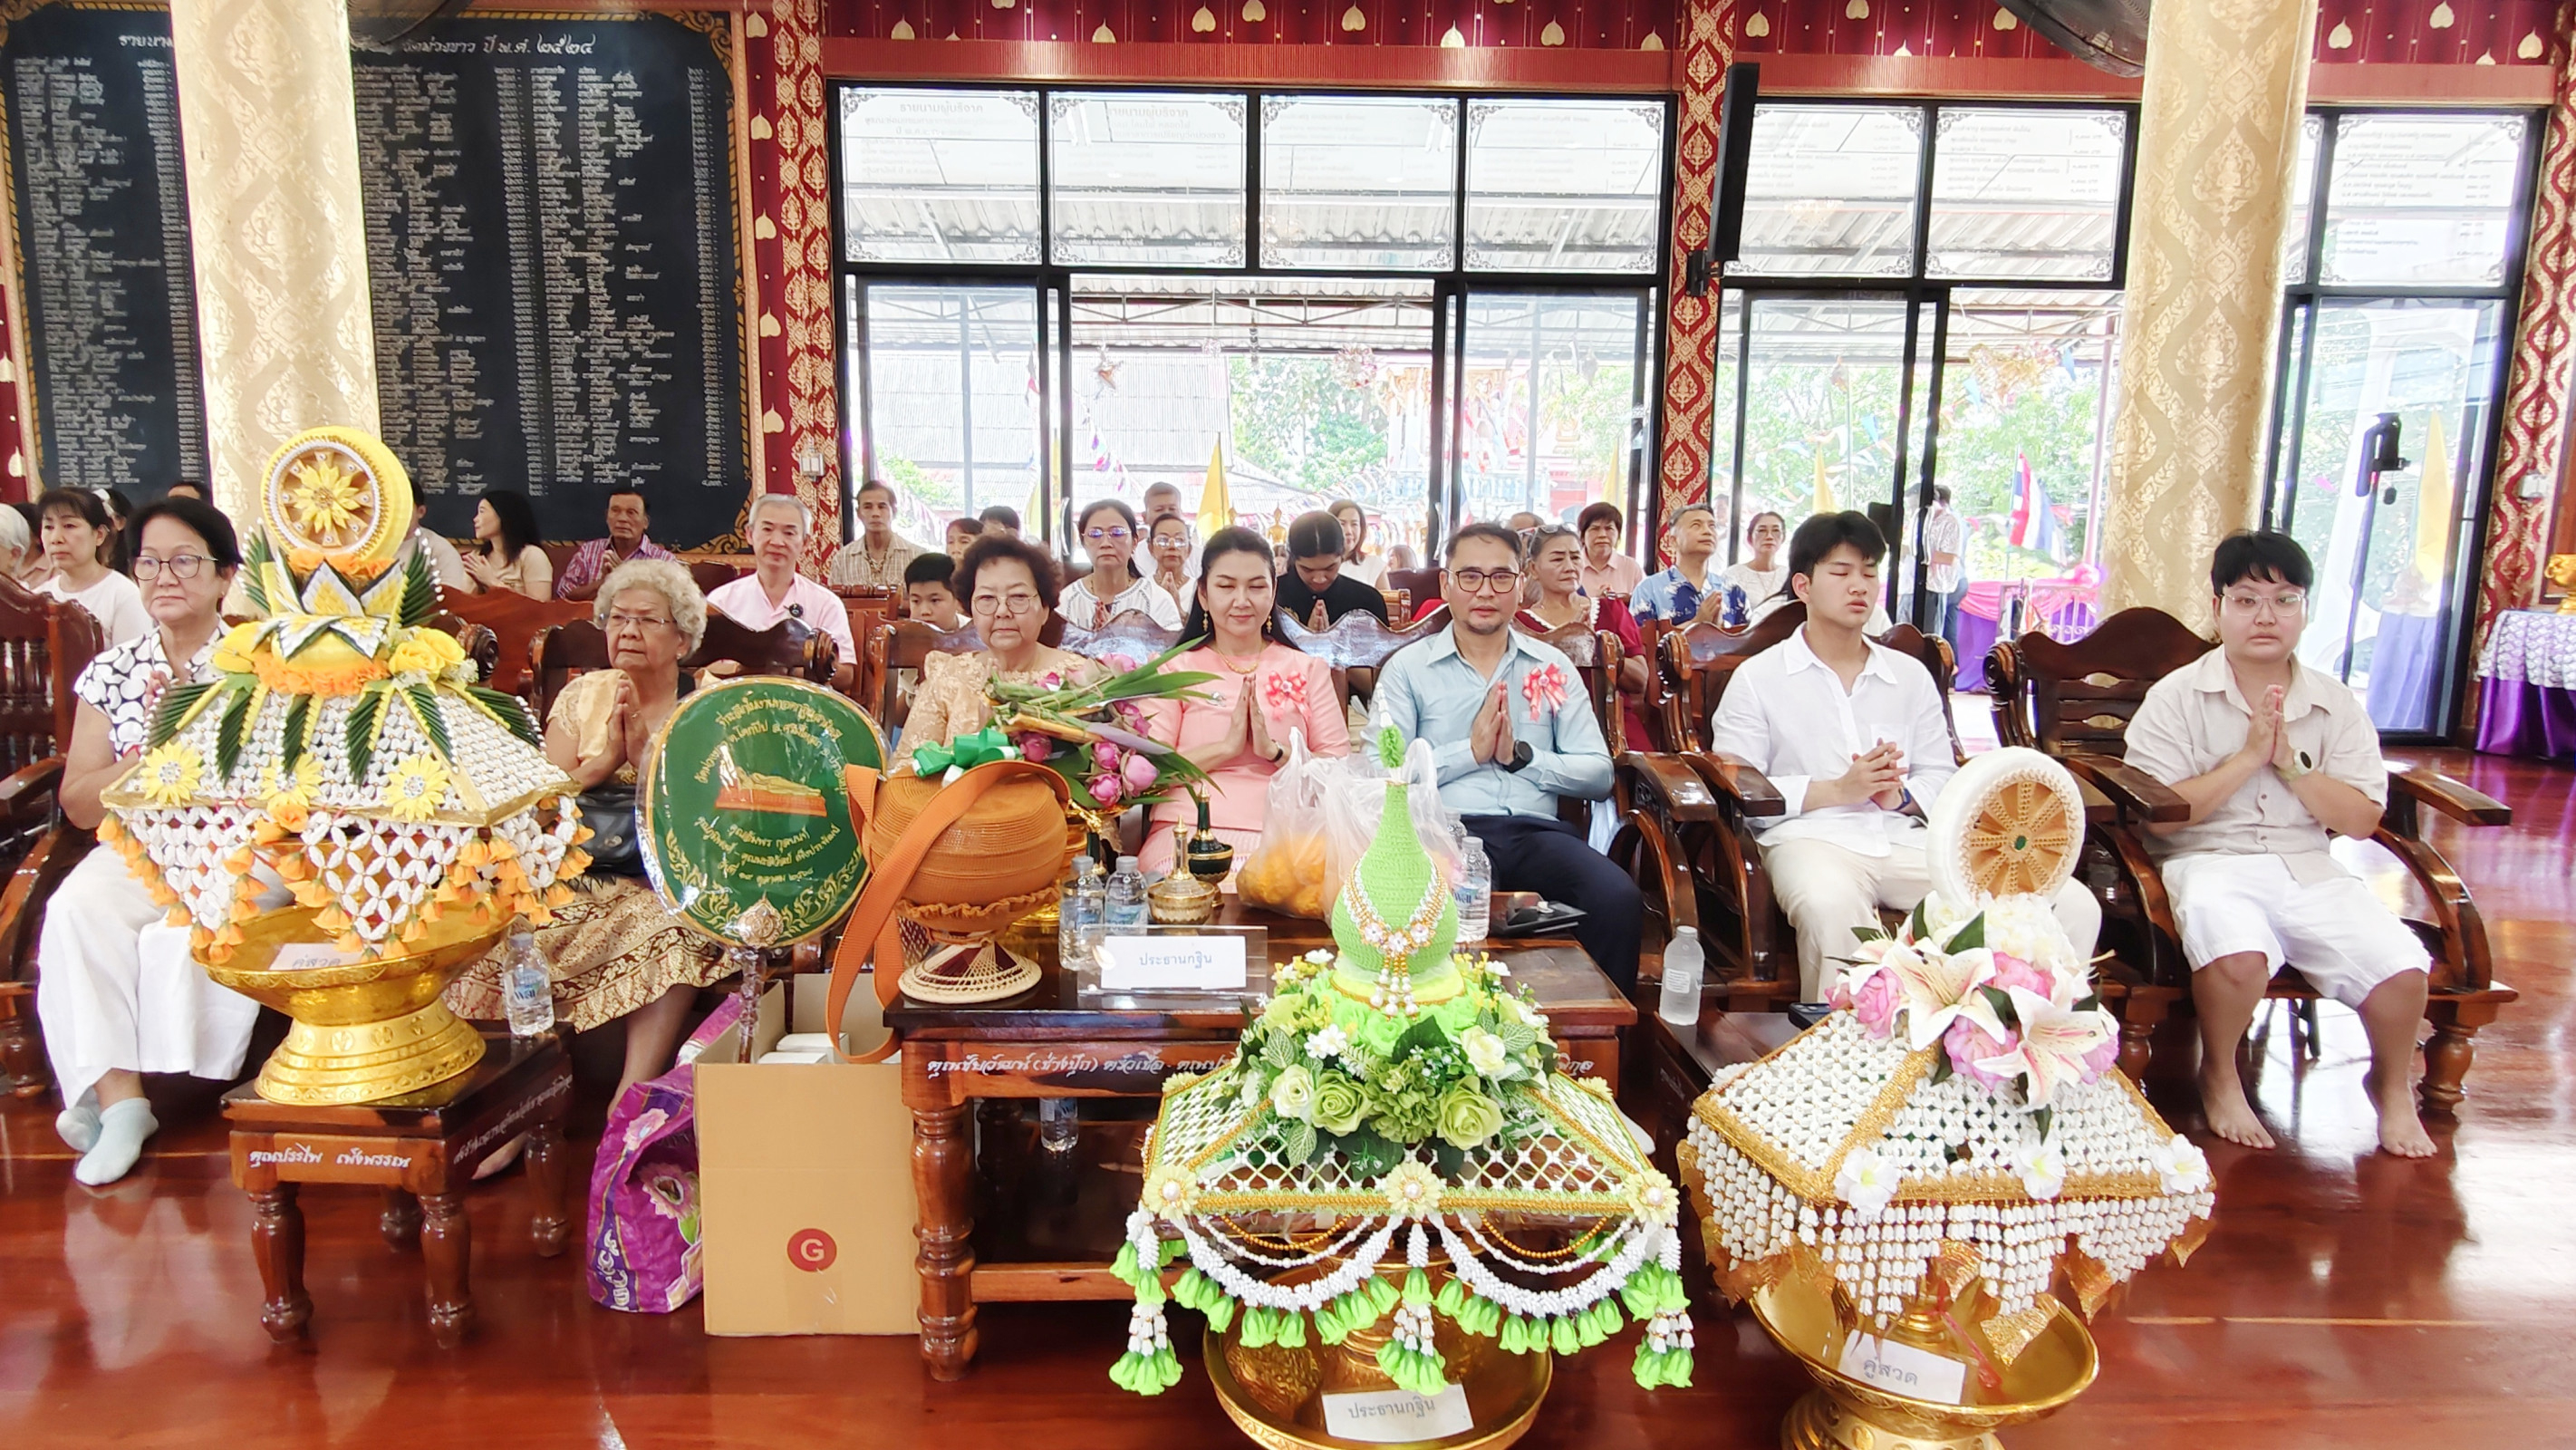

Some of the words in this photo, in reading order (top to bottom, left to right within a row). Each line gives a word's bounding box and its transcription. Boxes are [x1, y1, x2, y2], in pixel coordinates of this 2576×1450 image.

[1139, 951, 1212, 970] ประธานกฐิน
[801, 1238, 825, 1262] G
[1863, 1357, 1919, 1386] คู่สวด
[1347, 1396, 1436, 1420] ประธานกฐิน
